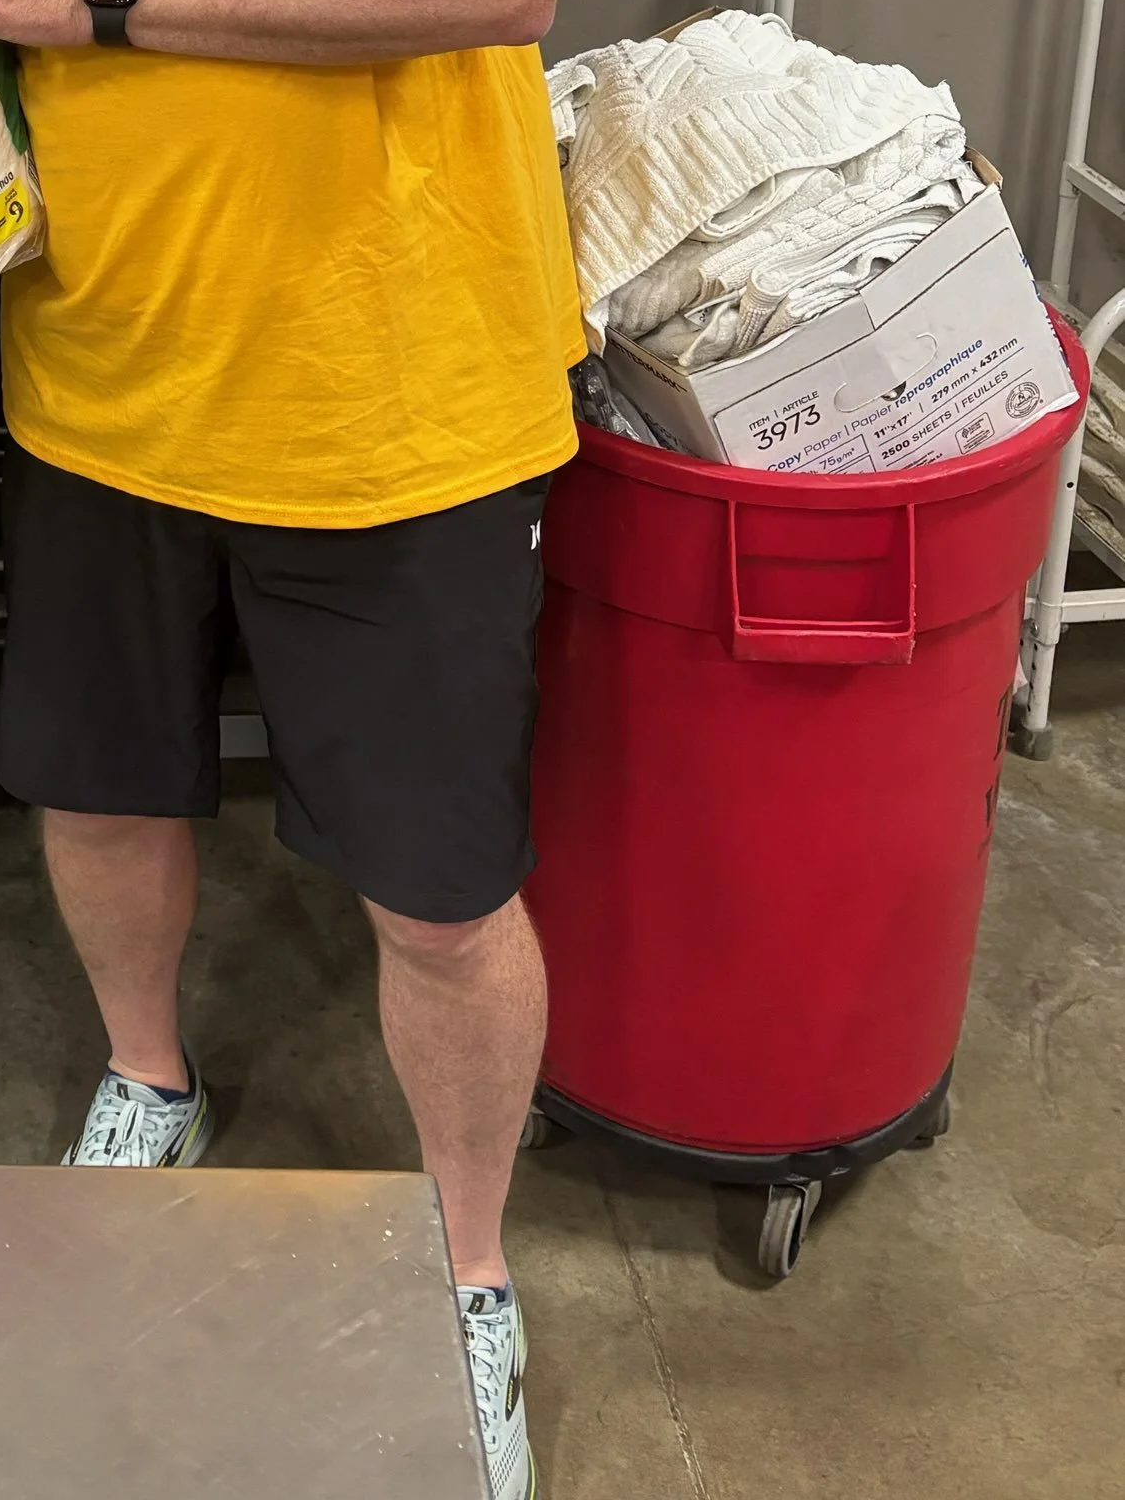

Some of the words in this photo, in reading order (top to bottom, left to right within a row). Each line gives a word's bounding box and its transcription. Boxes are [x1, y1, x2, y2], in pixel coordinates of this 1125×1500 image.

[9, 200, 24, 223] 6
[804, 431, 844, 457] Paper
[851, 403, 892, 432] Papier
[894, 339, 984, 409] reprographique
[931, 386, 949, 404] 279
[951, 371, 970, 391] mm
[979, 349, 999, 368] 432
[998, 337, 1018, 355] mm
[749, 416, 770, 432] ITEM
[782, 390, 820, 415] ARTICLE
[753, 403, 821, 451] 3973
[881, 439, 910, 460] 2500
[912, 411, 953, 442] SHEETS
[961, 370, 1009, 408] FEUILLES
